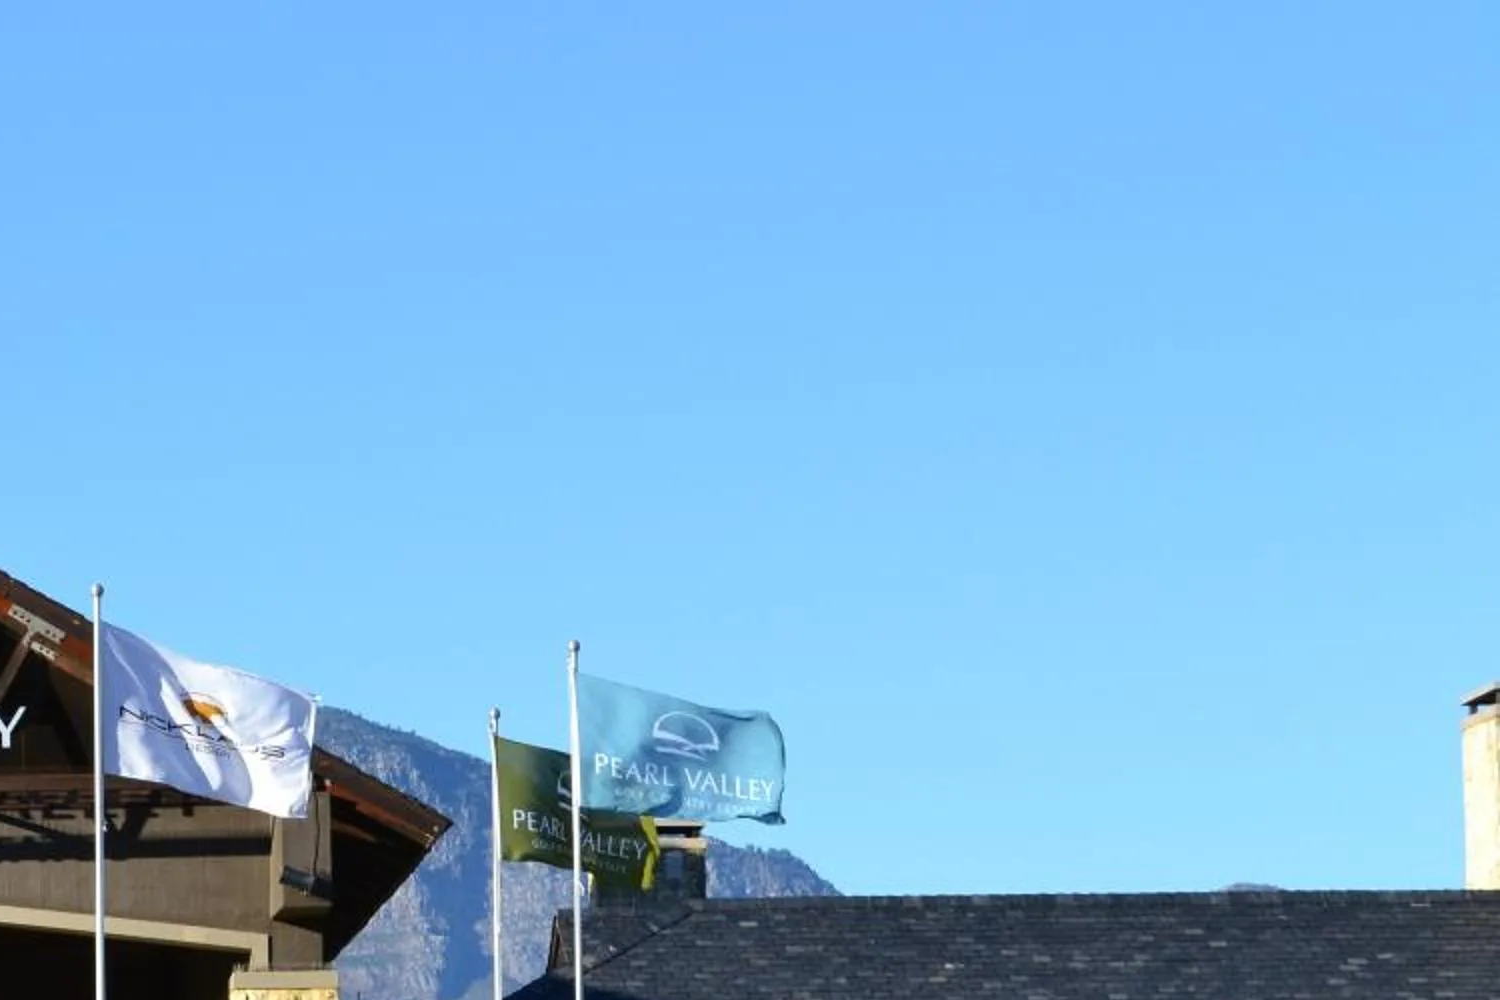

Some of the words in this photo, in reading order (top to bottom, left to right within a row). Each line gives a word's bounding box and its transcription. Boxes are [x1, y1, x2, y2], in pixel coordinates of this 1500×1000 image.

[594, 752, 675, 787] PEARL
[684, 767, 775, 802] VALLEY
[512, 808, 567, 842] PEARL
